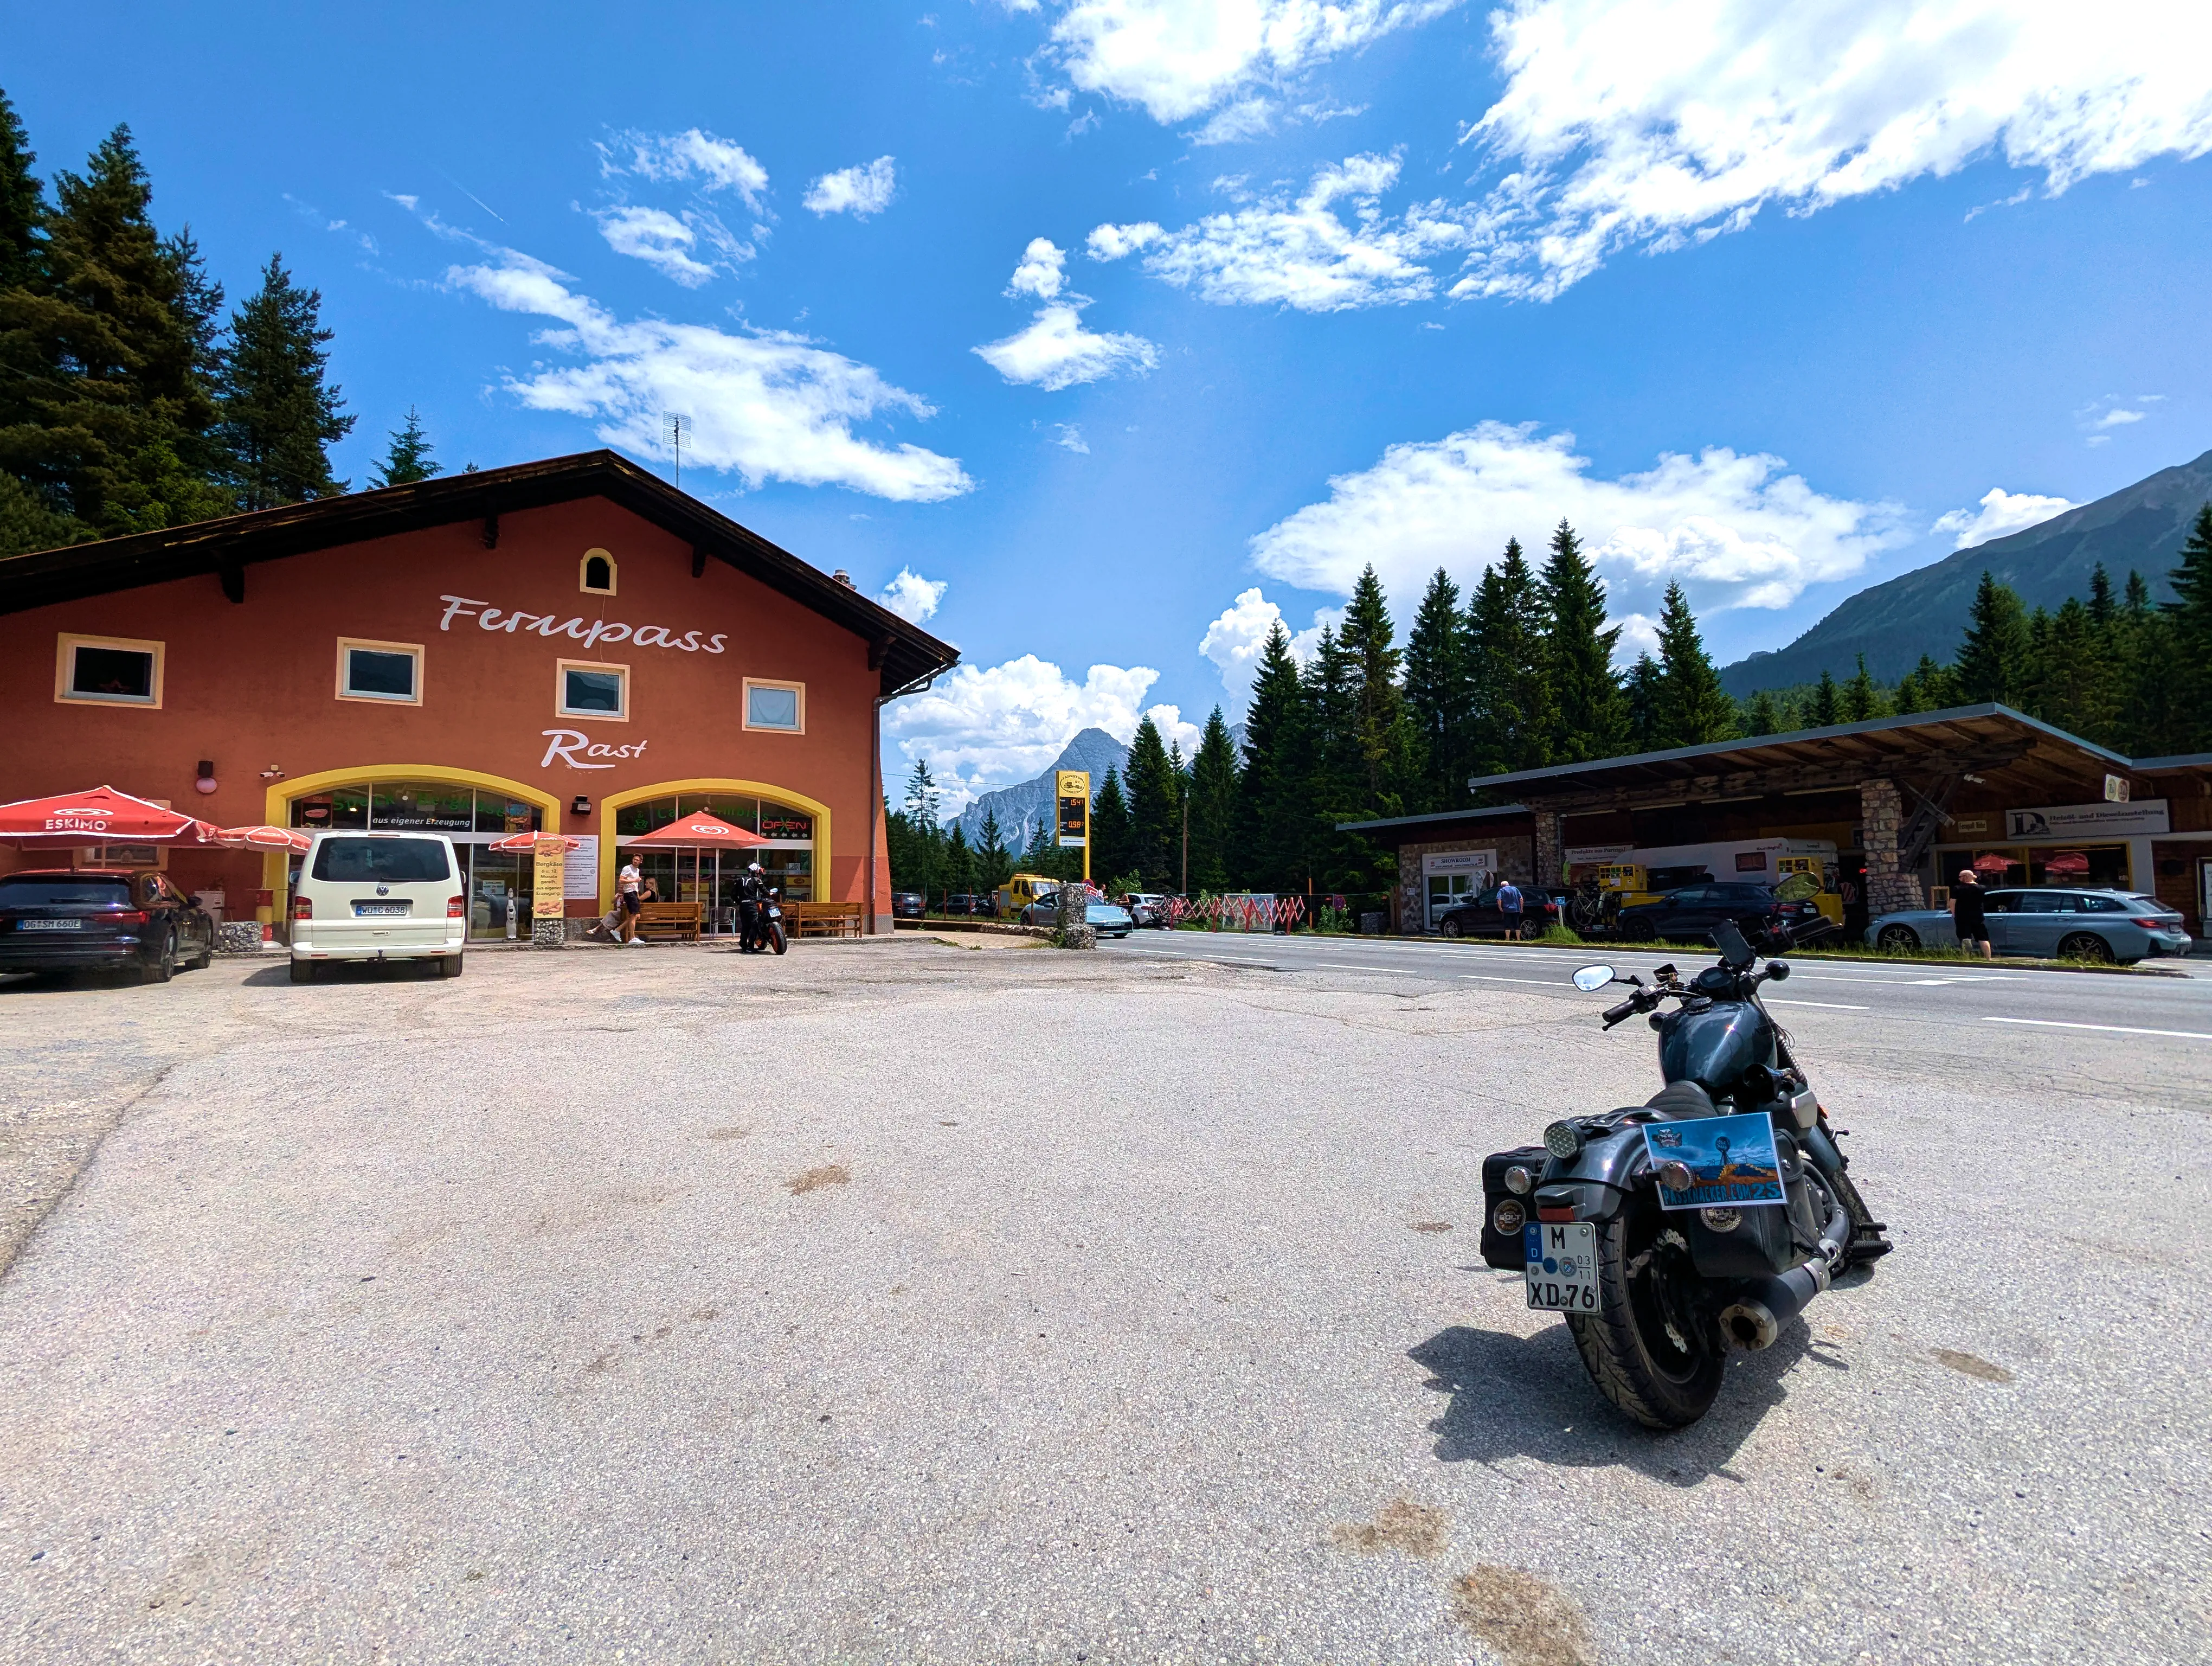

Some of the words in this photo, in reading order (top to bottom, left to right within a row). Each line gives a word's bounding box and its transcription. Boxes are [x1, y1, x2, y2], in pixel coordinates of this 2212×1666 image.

[439, 594, 728, 654] Fernpass
[541, 729, 648, 769] Rast
[45, 818, 107, 831] ESKIMO
[391, 817, 425, 825] eigener
[426, 817, 471, 828] Erzeugung
[762, 821, 807, 830] OPEN
[1551, 1226, 1566, 1250] M
[1531, 1247, 1538, 1258] D
[1577, 1255, 1591, 1265] 03
[1579, 1270, 1591, 1280] 11
[1530, 1282, 1560, 1306] XD
[1565, 1284, 1595, 1309] 76
